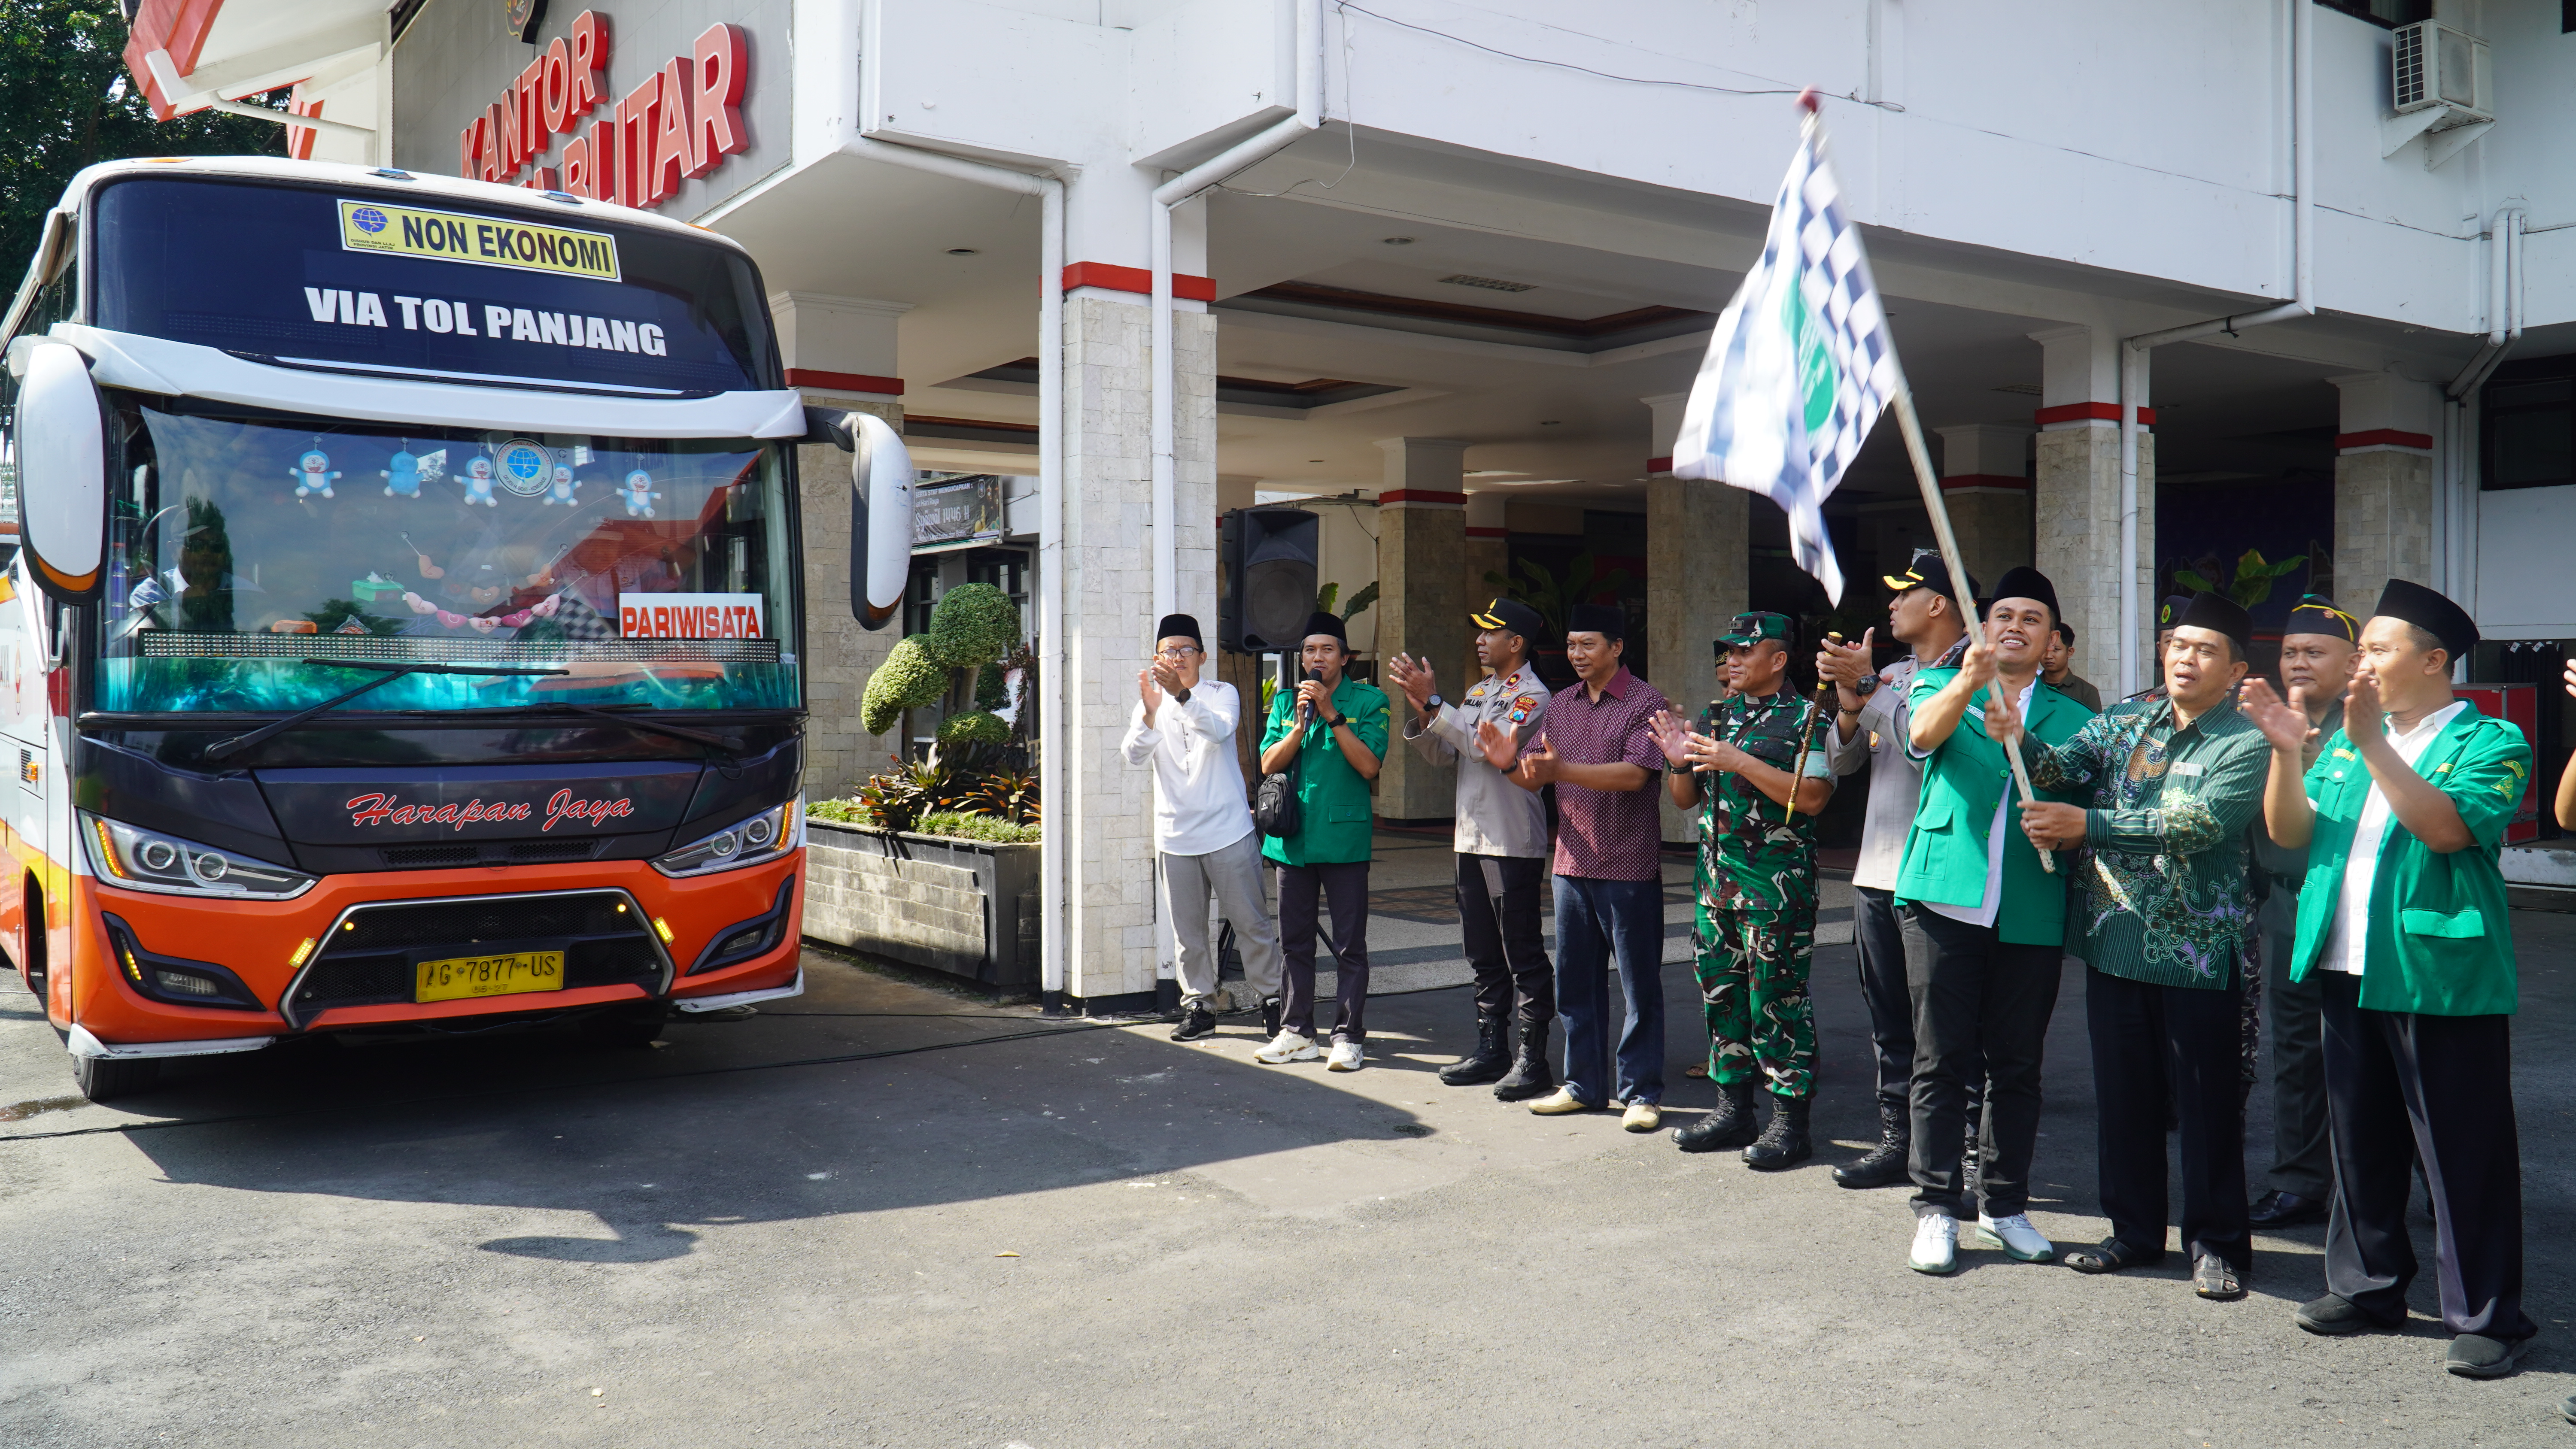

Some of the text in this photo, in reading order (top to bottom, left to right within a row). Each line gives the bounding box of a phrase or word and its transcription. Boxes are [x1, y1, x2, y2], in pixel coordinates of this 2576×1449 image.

[461, 9, 609, 183] KANTOR
[563, 22, 750, 207] BLITAR
[402, 215, 611, 272] NON EKONOMI
[304, 287, 667, 356] VIA TOL PANJANG
[498, 441, 550, 464] INSPEKSI KESELAMATAN LLAJ
[503, 475, 513, 488] DITJEN
[943, 506, 961, 523] 1446
[964, 505, 970, 520] H
[621, 606, 761, 639] PARIWISATA
[346, 788, 635, 832] Harapan Jaya
[466, 957, 516, 983] 7877
[532, 955, 556, 976] US
